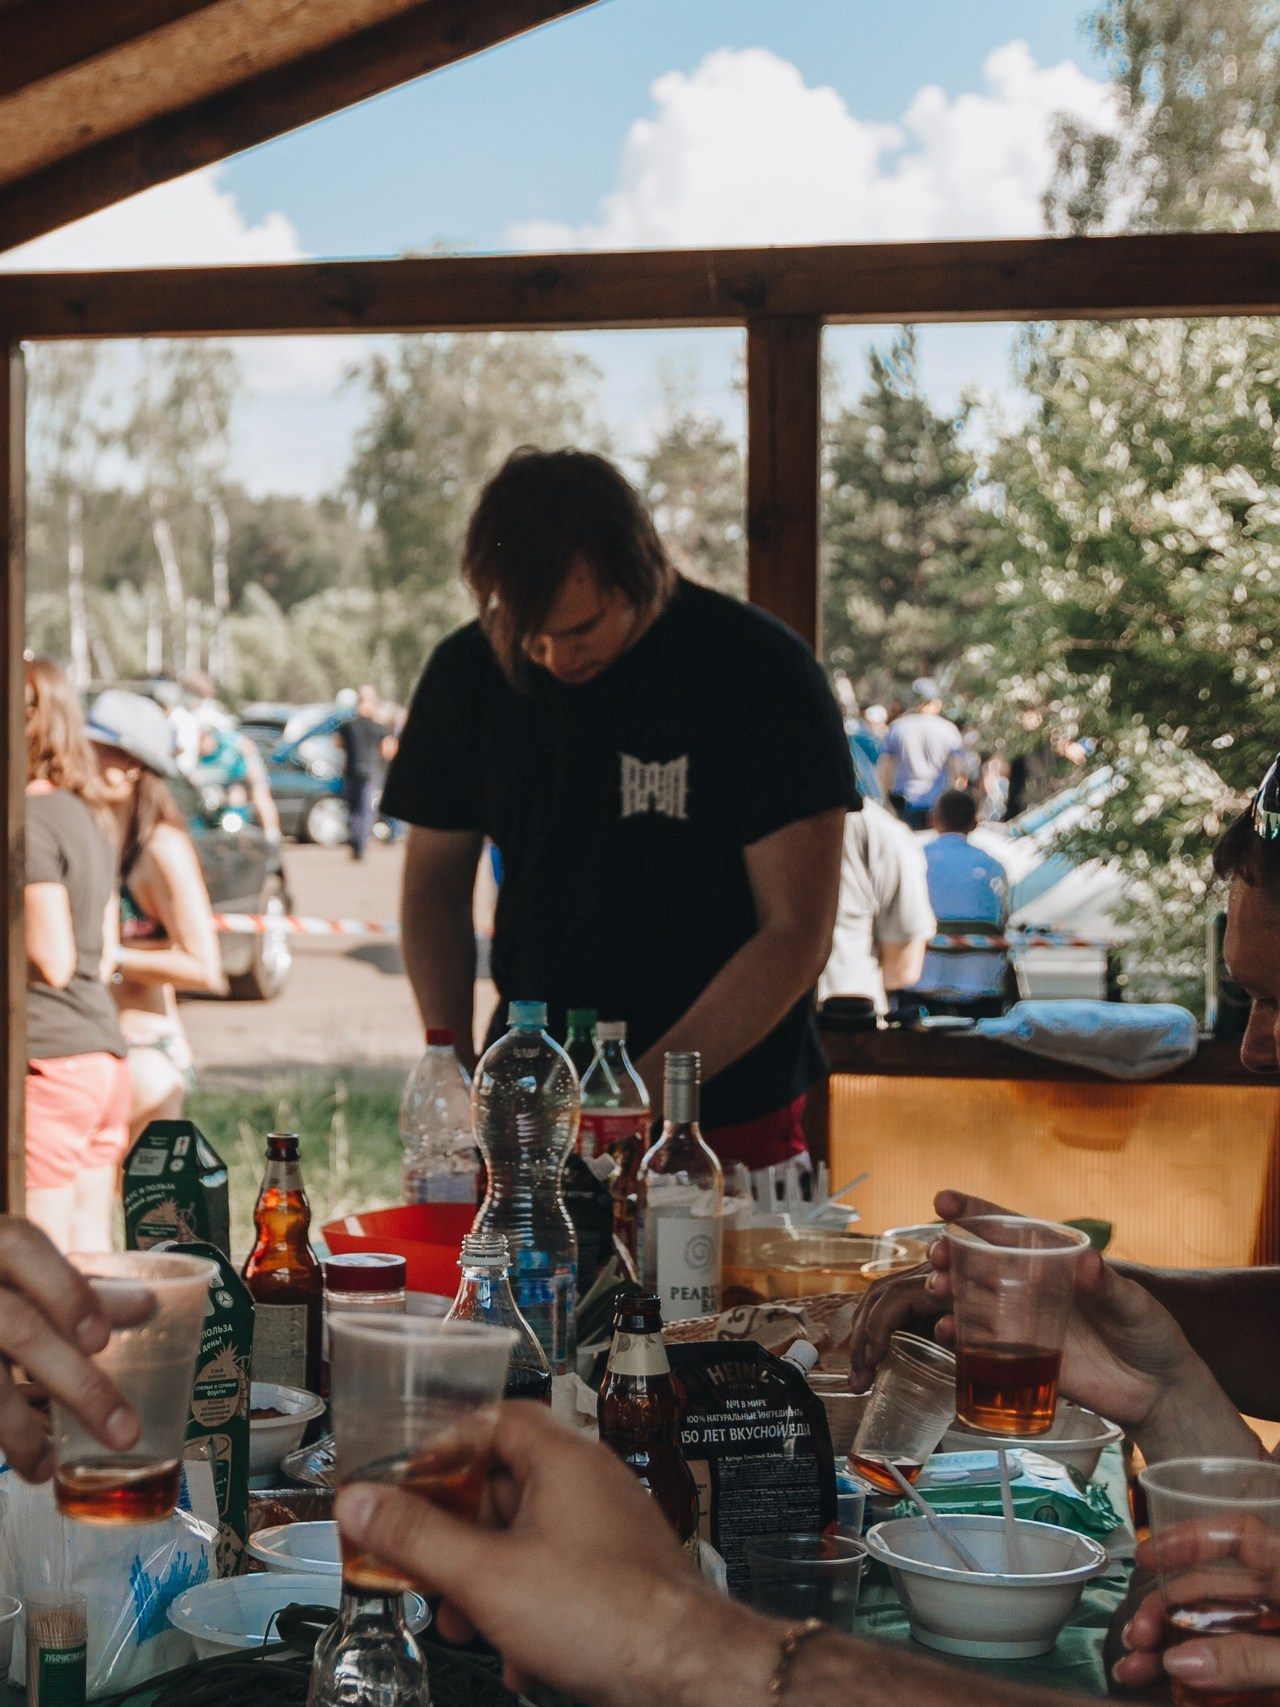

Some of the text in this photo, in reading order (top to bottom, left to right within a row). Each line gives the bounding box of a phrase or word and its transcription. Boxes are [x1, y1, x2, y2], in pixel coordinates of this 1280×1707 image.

[201, 1323, 233, 1339] ПОЛЬЗА
[202, 1337, 222, 1353] день!
[706, 1361, 770, 1386] HEINZ
[706, 1411, 757, 1423] НАТУРАЛЬНЫЕ
[681, 1421, 811, 1443] 150 ЛЕТ ВКУСНОЙ ЕДЫ
